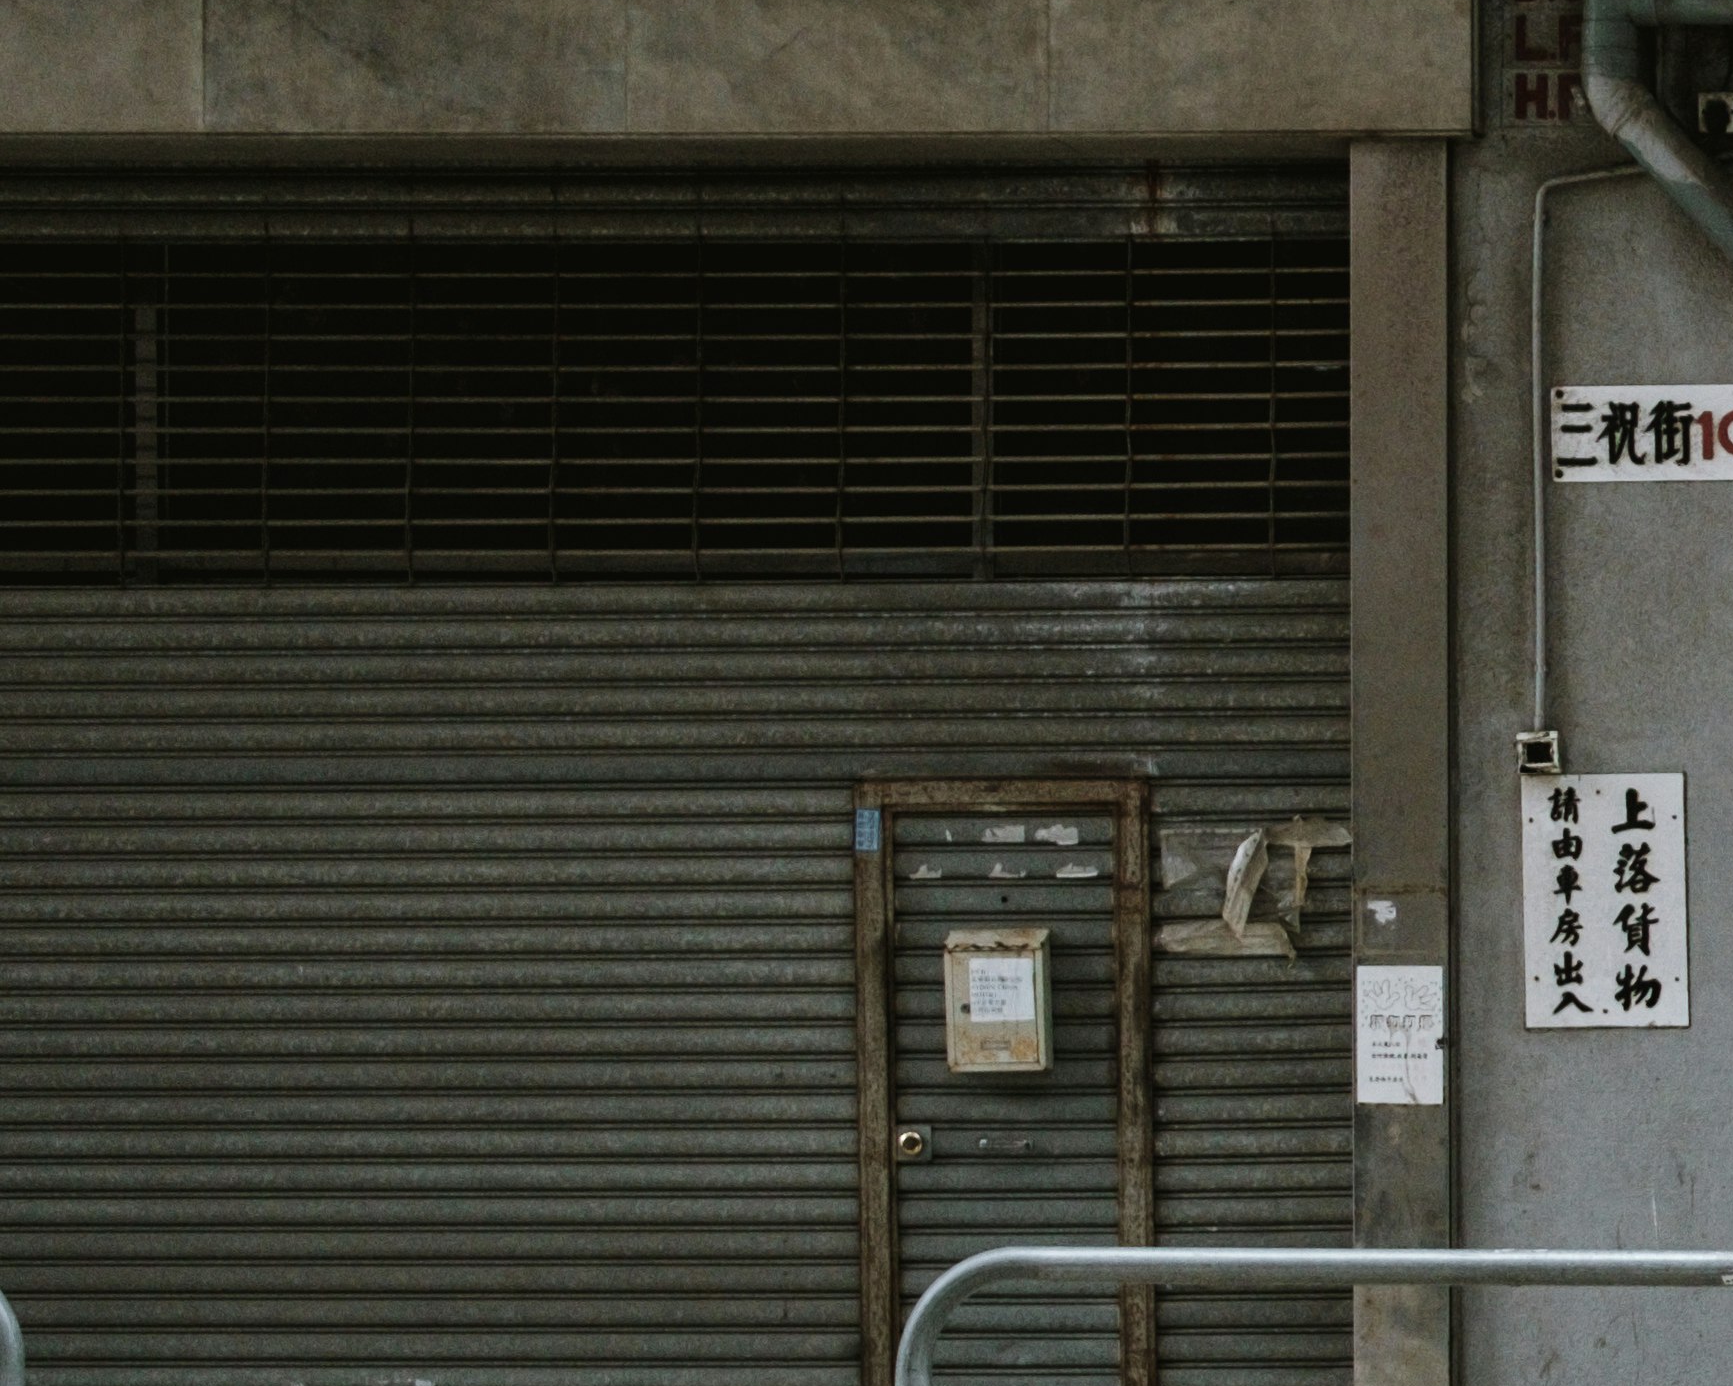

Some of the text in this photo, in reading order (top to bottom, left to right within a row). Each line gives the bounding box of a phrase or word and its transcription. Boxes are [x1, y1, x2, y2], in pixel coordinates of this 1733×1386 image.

[1547, 786, 1594, 1015] 請由車房出入
[1611, 787, 1663, 1012] 上落貨物
